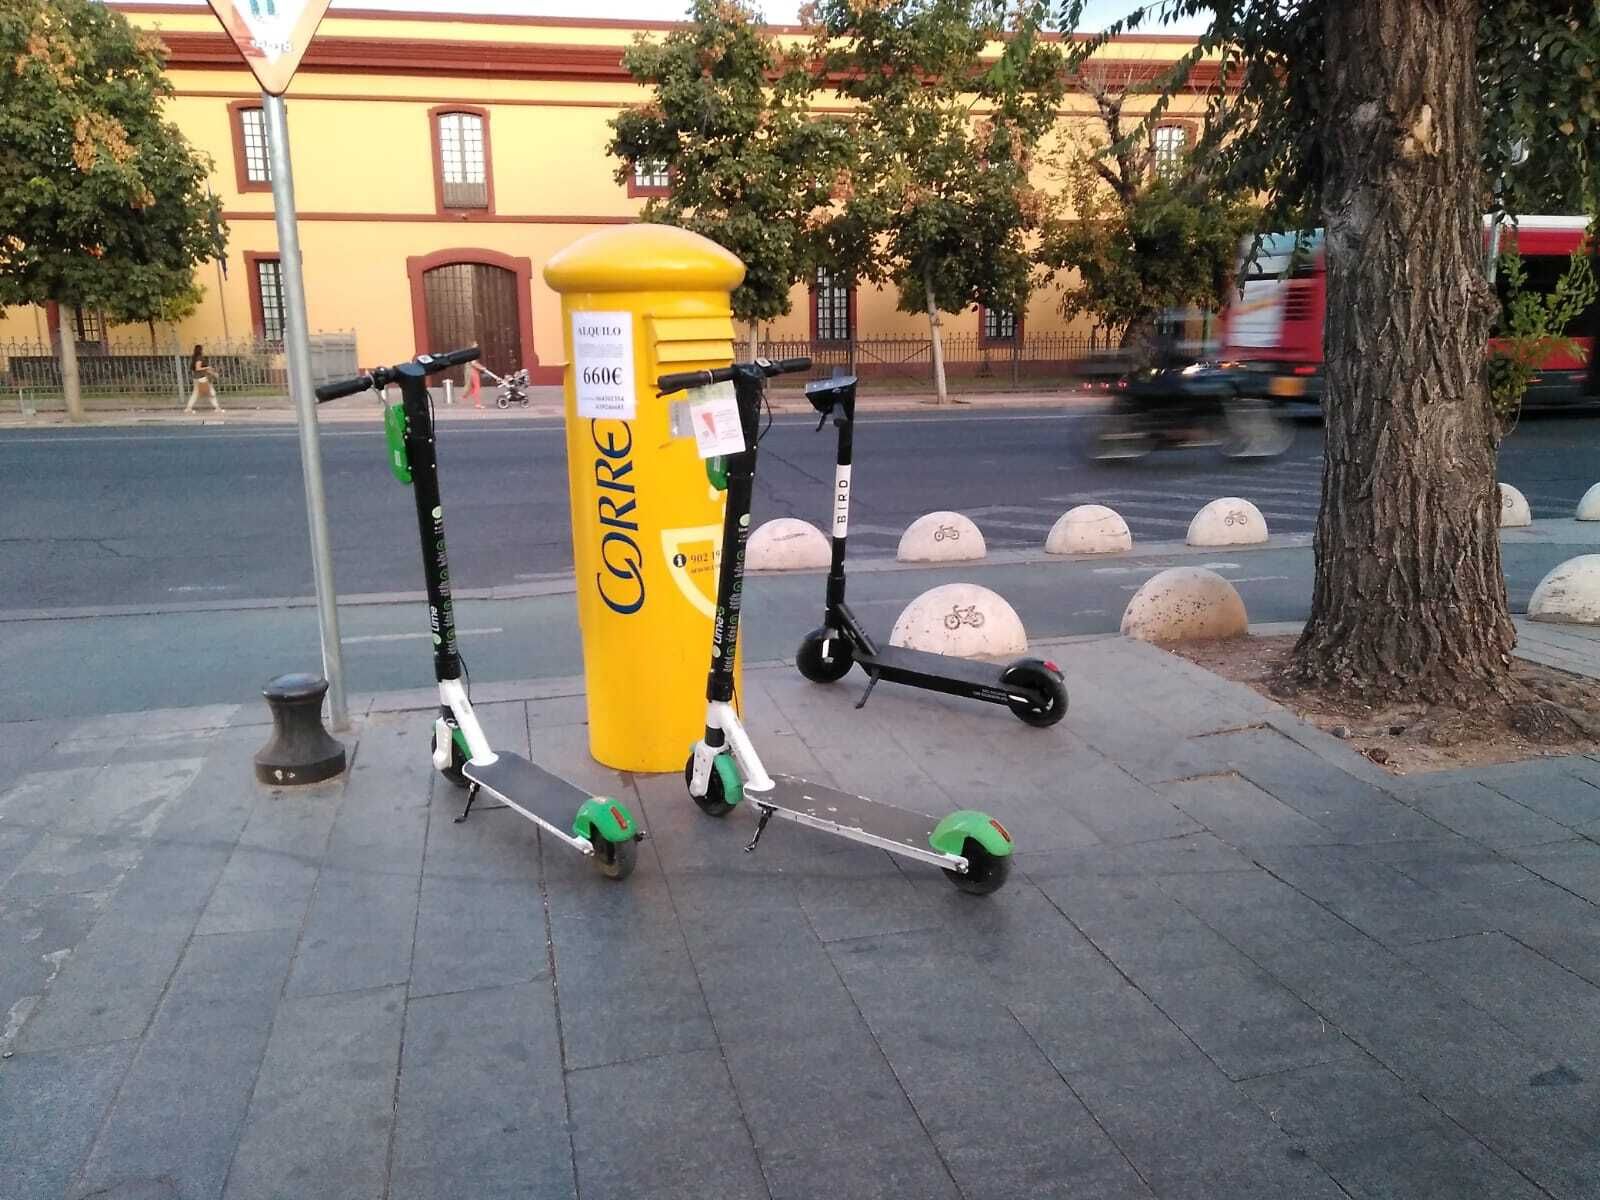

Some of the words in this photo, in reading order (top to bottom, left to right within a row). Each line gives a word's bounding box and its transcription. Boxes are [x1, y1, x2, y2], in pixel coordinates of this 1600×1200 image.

[576, 326, 622, 338] ALQUILO
[582, 366, 624, 386] 660€
[836, 479, 849, 524] BIRD
